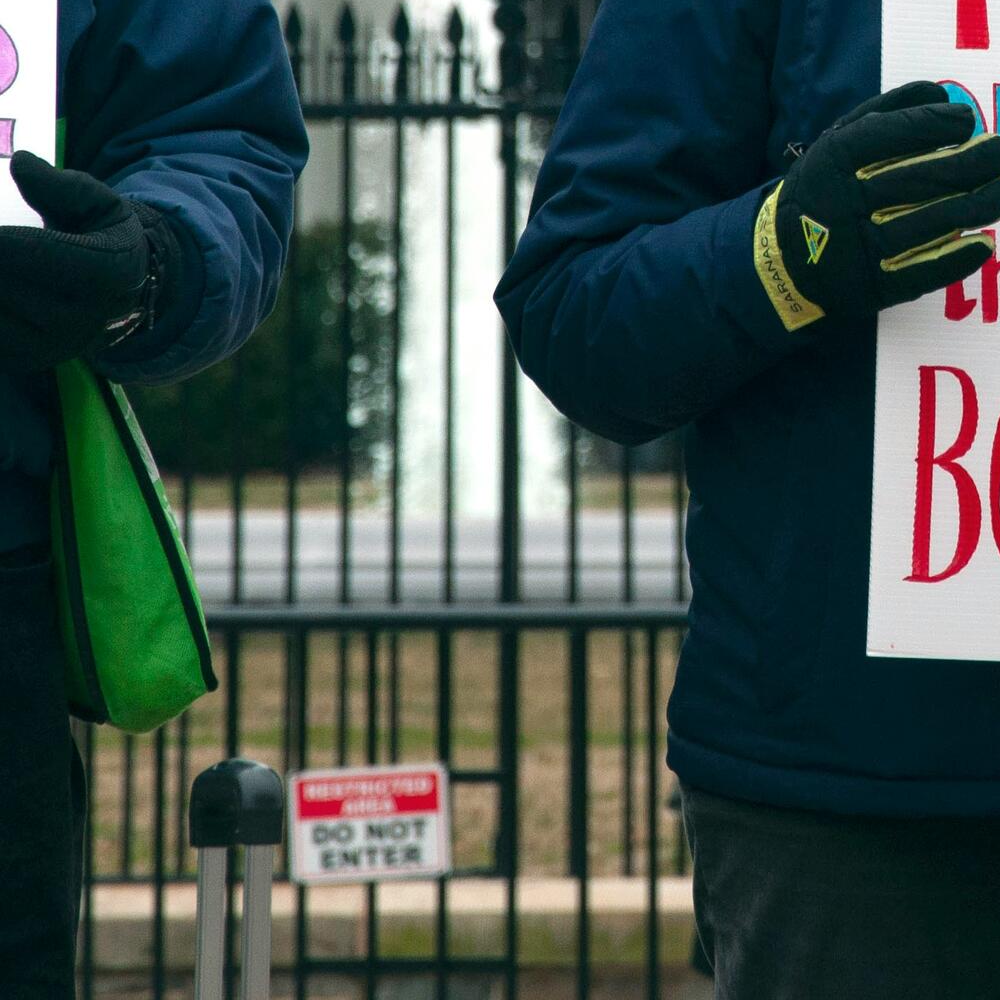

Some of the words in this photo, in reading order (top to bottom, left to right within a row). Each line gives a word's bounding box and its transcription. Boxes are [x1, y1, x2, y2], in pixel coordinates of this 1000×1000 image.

[760, 236, 803, 313] SARANAC
[303, 777, 434, 800] RESTRICTED
[342, 798, 397, 816] AREA
[311, 823, 355, 846] DO
[365, 818, 426, 840] NOT
[320, 845, 422, 870] ENTER
